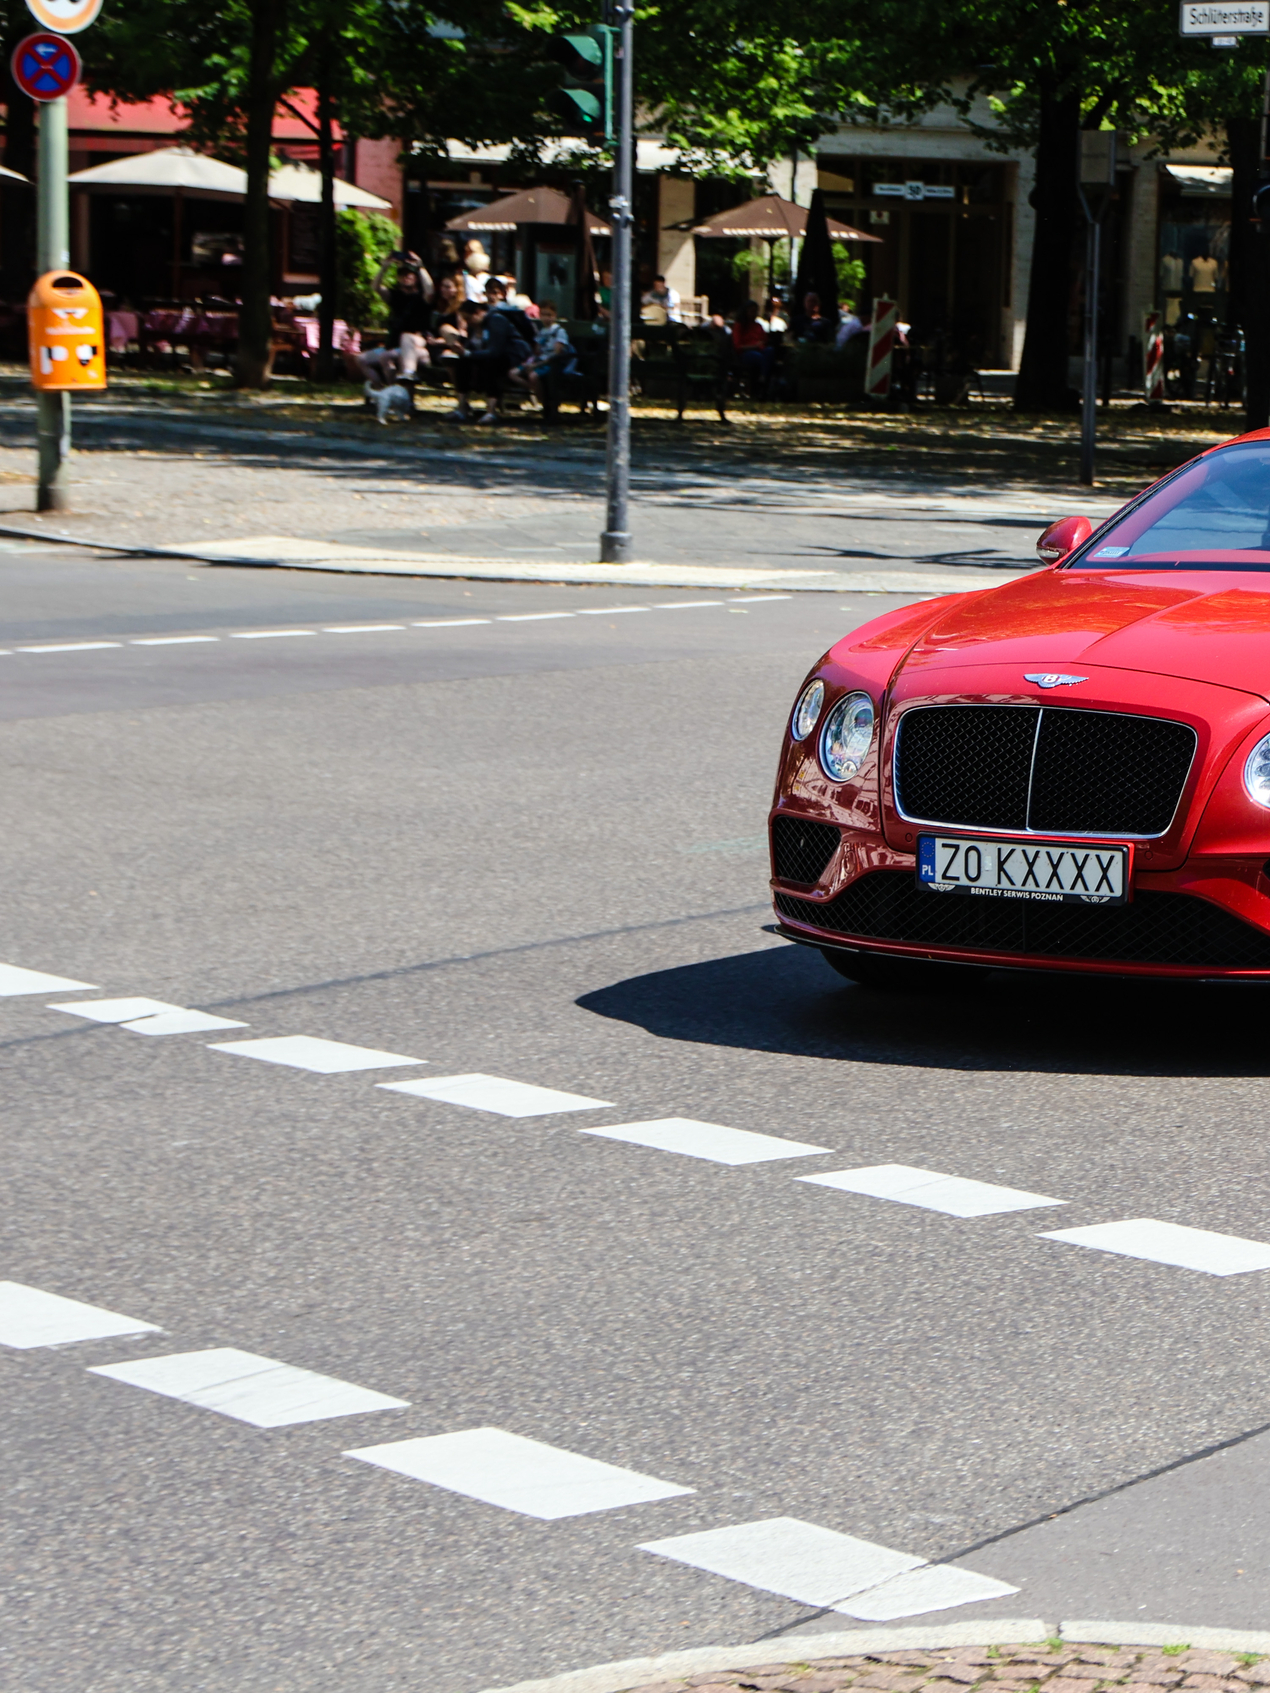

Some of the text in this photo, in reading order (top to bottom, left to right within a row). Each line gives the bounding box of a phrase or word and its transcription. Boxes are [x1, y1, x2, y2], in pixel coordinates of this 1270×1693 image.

[1189, 7, 1264, 27] Schlüterstraße
[921, 864, 934, 876] PL
[996, 847, 1115, 893] KXXXX
[970, 887, 1064, 902] BENTLEY SERWIS POZNAŃ
